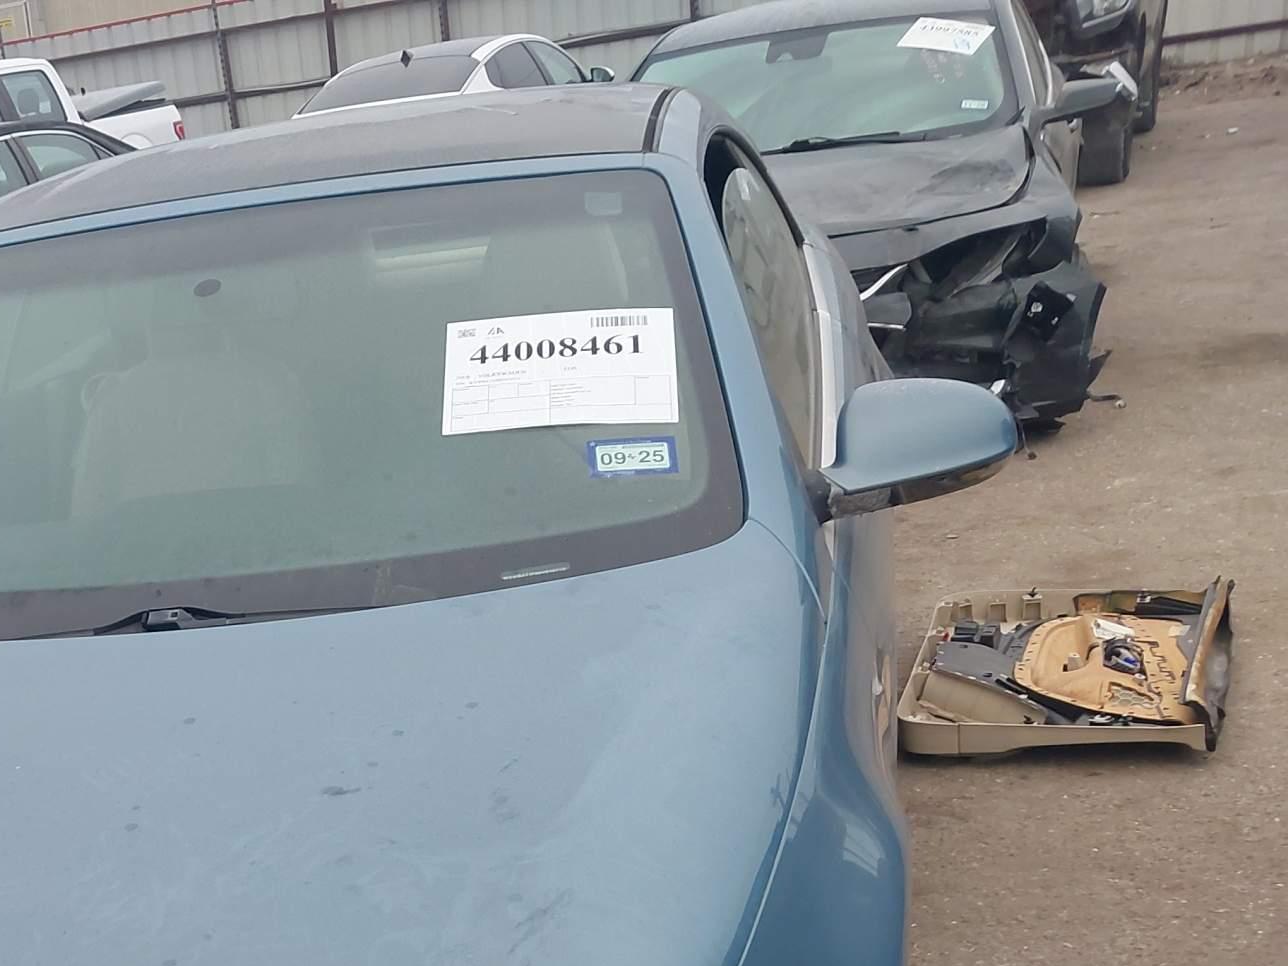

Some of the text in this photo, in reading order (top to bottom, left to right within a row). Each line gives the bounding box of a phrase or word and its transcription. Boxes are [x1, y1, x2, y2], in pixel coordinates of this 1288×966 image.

[469, 334, 644, 364] 44008461
[600, 449, 665, 466] 09 25
